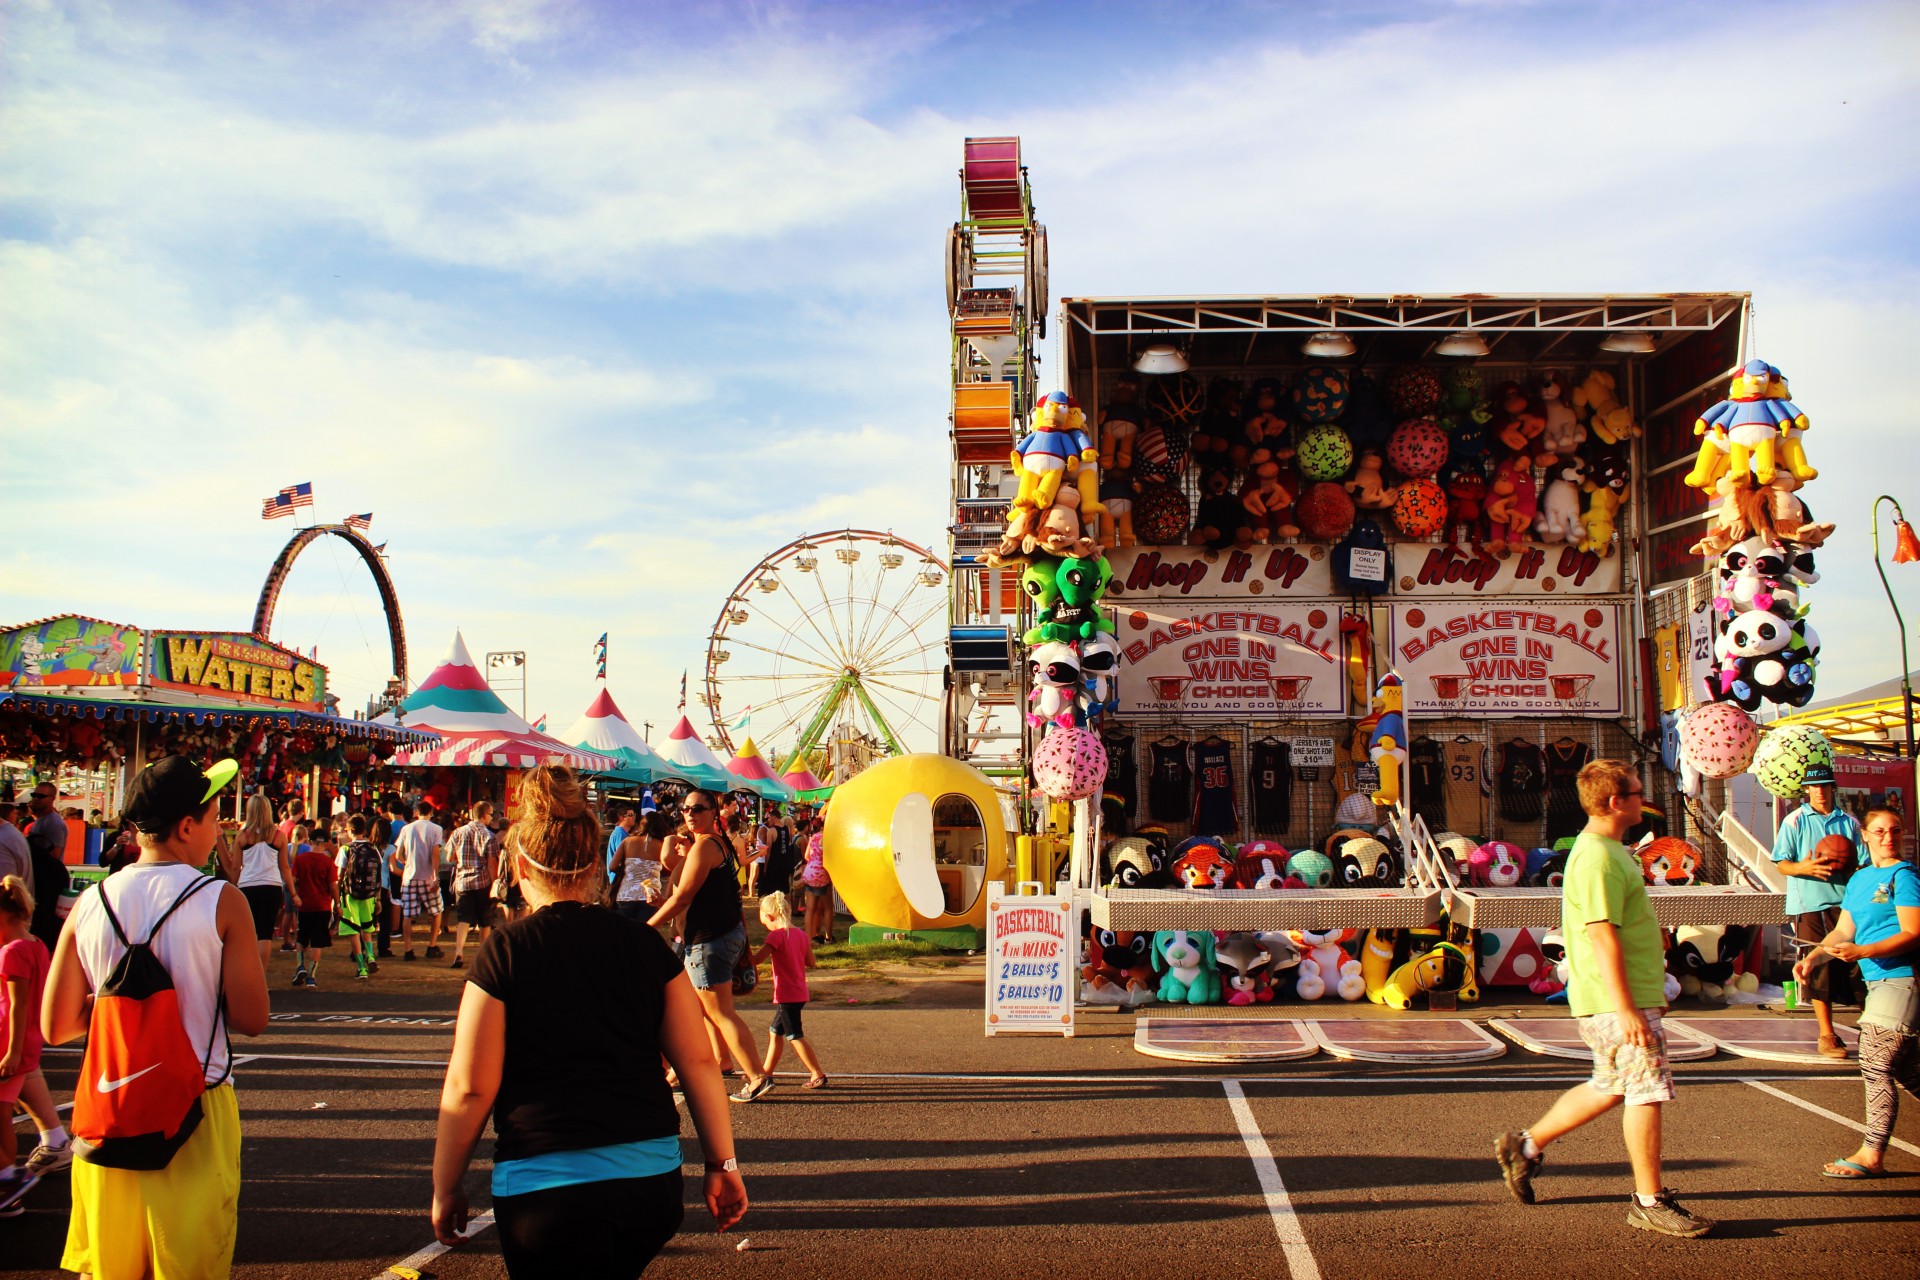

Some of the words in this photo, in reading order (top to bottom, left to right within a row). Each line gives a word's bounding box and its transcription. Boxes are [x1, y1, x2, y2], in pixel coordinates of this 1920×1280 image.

[1354, 549, 1382, 557] DISPLAY
[1359, 556, 1376, 564] ONLY
[1125, 551, 1208, 595] Hoop
[1221, 550, 1252, 583] It
[1264, 547, 1309, 590] Up
[1417, 547, 1501, 592] Hoop
[1514, 547, 1545, 580] It
[1557, 545, 1601, 588] Up
[1122, 611, 1336, 665] BASKETBALL
[1400, 610, 1612, 664] BASKETBALL
[218, 641, 289, 667] RISING
[1182, 637, 1240, 662] ONE
[1248, 638, 1277, 662] IN
[1460, 636, 1518, 661] ONE
[1526, 637, 1554, 661] IN
[1694, 636, 1709, 661] 23
[168, 637, 316, 703] WATERS
[1188, 659, 1272, 683] WINS
[1466, 658, 1548, 681] WINS
[1664, 650, 1672, 672] 2
[1192, 685, 1270, 699] CHOICE
[1470, 684, 1547, 698] CHOICE
[1294, 747, 1305, 755] ONE
[1306, 747, 1320, 755] SHOT
[1322, 747, 1333, 755] FOR
[1295, 739, 1318, 747] JERSEYS
[1320, 739, 1331, 747] ARE
[1203, 766, 1230, 789] 36
[1262, 770, 1275, 789] 9
[1451, 765, 1475, 782] 93
[1871, 766, 1885, 775] UNIT
[996, 908, 1064, 939] BASKETBALL
[1002, 941, 1009, 957] 1
[1010, 947, 1020, 957] IN
[1022, 941, 1058, 958] WINS
[1001, 962, 1010, 979] 2
[1011, 963, 1045, 977] BALLS
[1046, 962, 1059, 979] $5
[998, 985, 1006, 1002] 5
[1007, 986, 1040, 999] BALLS
[1042, 984, 1063, 1002] $10
